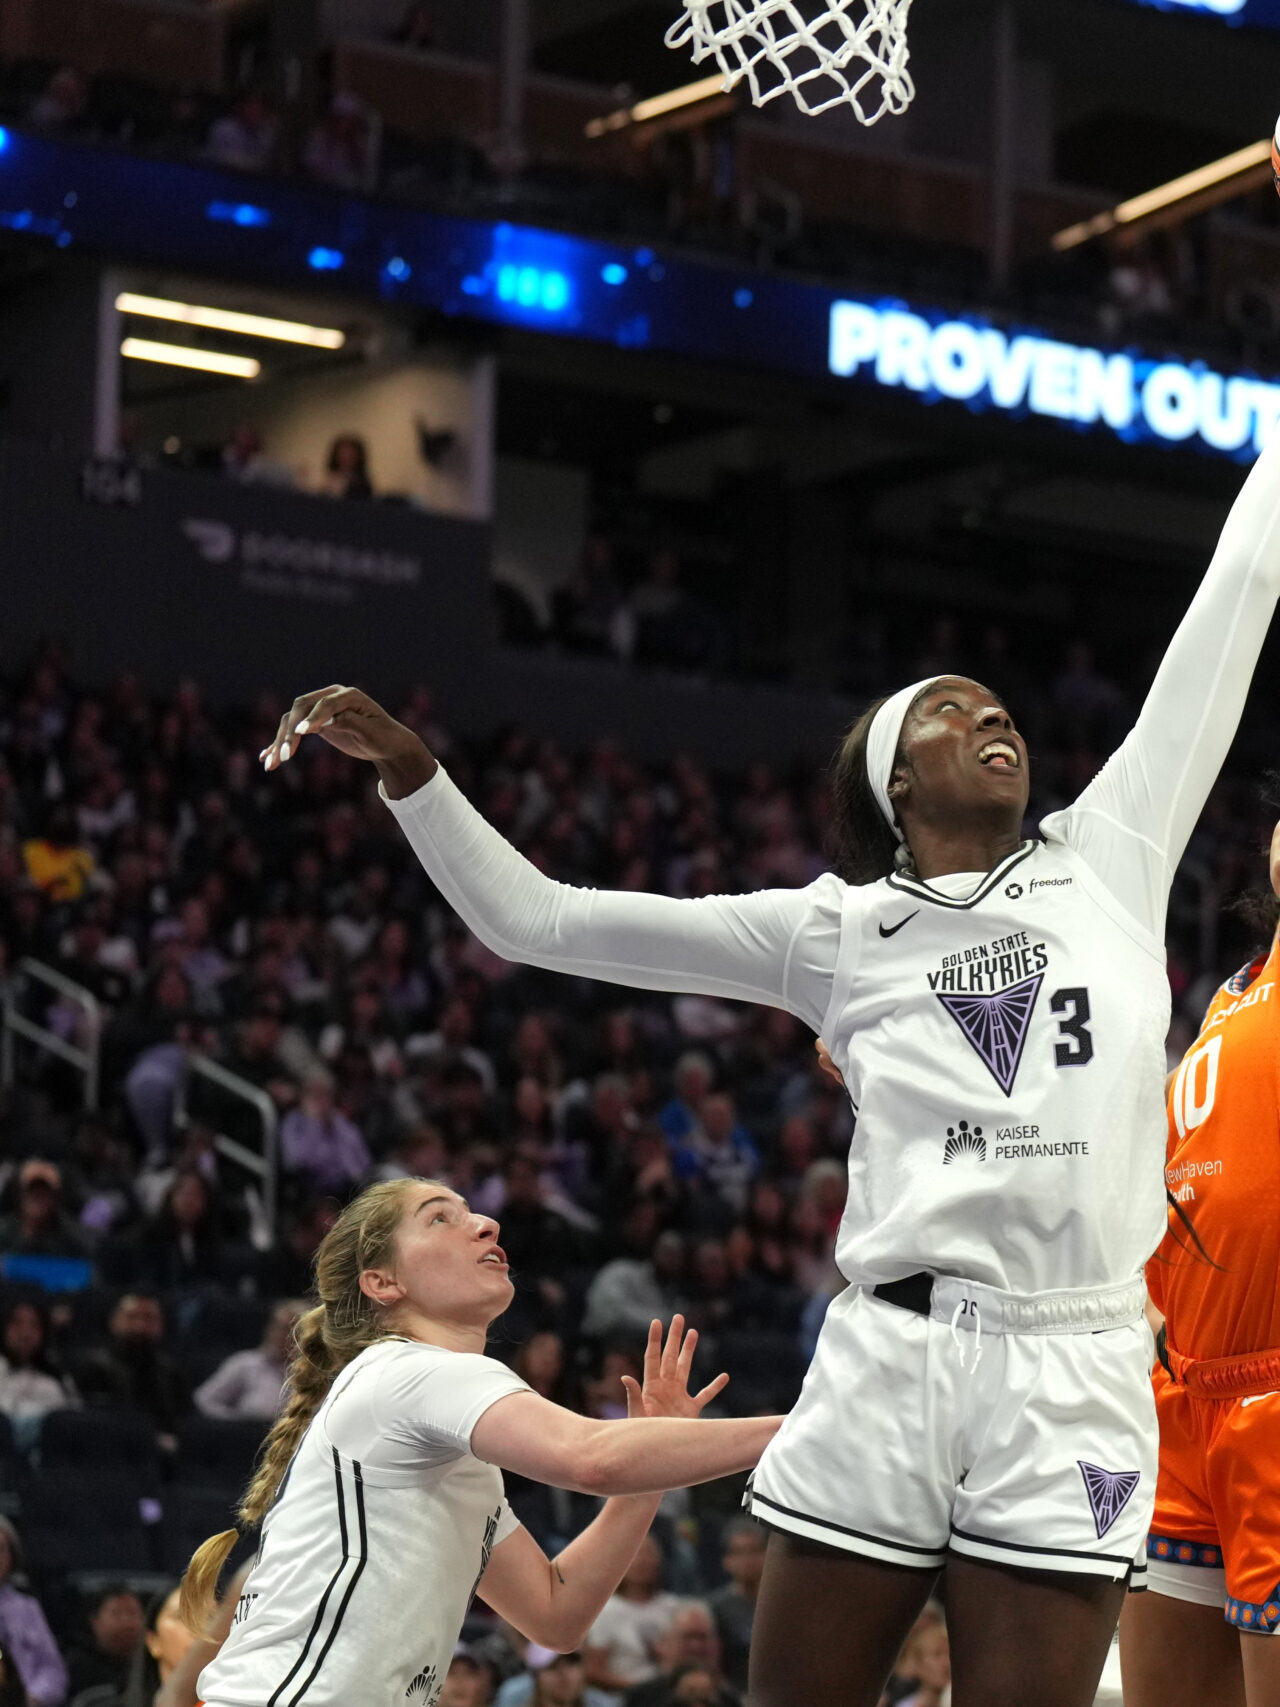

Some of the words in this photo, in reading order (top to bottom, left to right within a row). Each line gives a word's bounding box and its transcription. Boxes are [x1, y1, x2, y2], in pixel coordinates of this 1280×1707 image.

[829, 299, 1134, 429] PROVEN
[1029, 877, 1073, 894] freedom
[926, 942, 1049, 992] VALKYRIES
[942, 944, 989, 969] GOLDEN
[991, 931, 1029, 955] STATE
[1049, 986, 1094, 1069] 3
[1173, 1034, 1223, 1140] 10
[995, 1141, 1090, 1159] PERMANENTE
[996, 1125, 1040, 1141] KAISER
